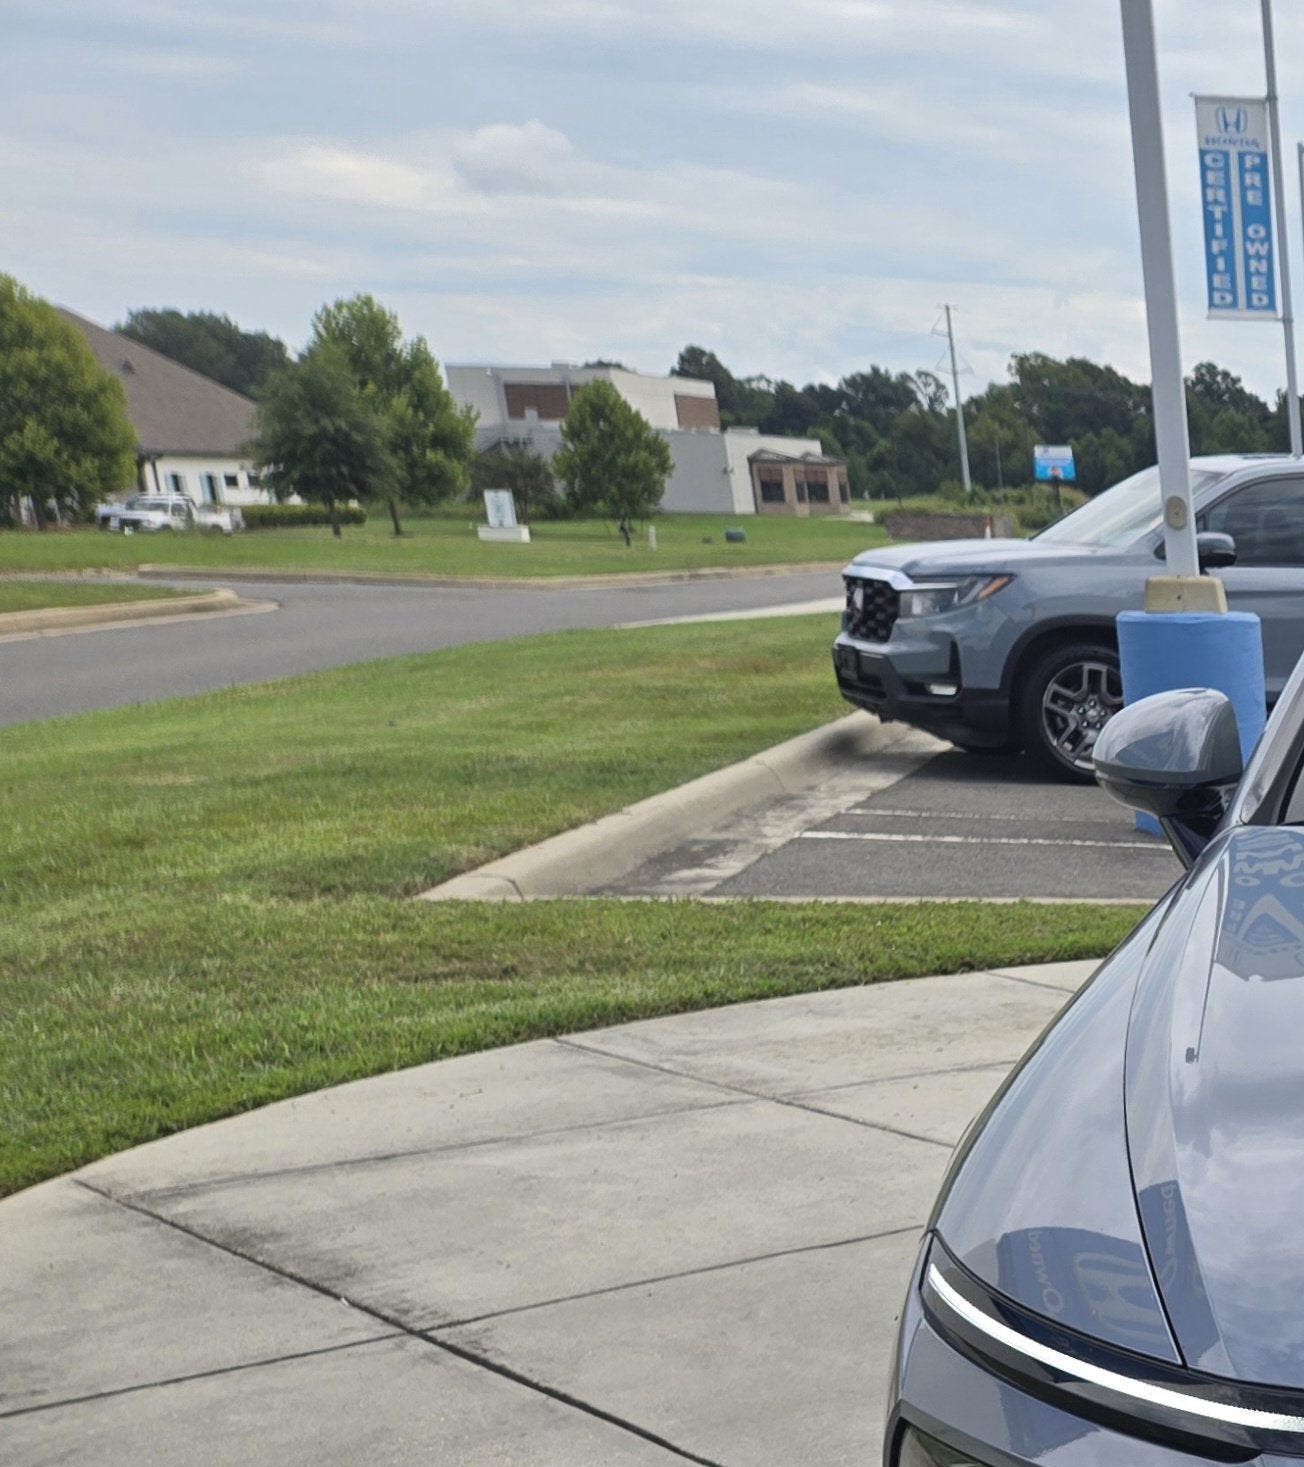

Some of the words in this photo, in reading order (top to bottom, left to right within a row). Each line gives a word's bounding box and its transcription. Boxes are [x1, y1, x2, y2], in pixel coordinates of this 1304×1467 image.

[1244, 153, 1264, 206] PRE
[1203, 152, 1233, 306] CERTIFIED
[1246, 223, 1270, 307] OWNED
